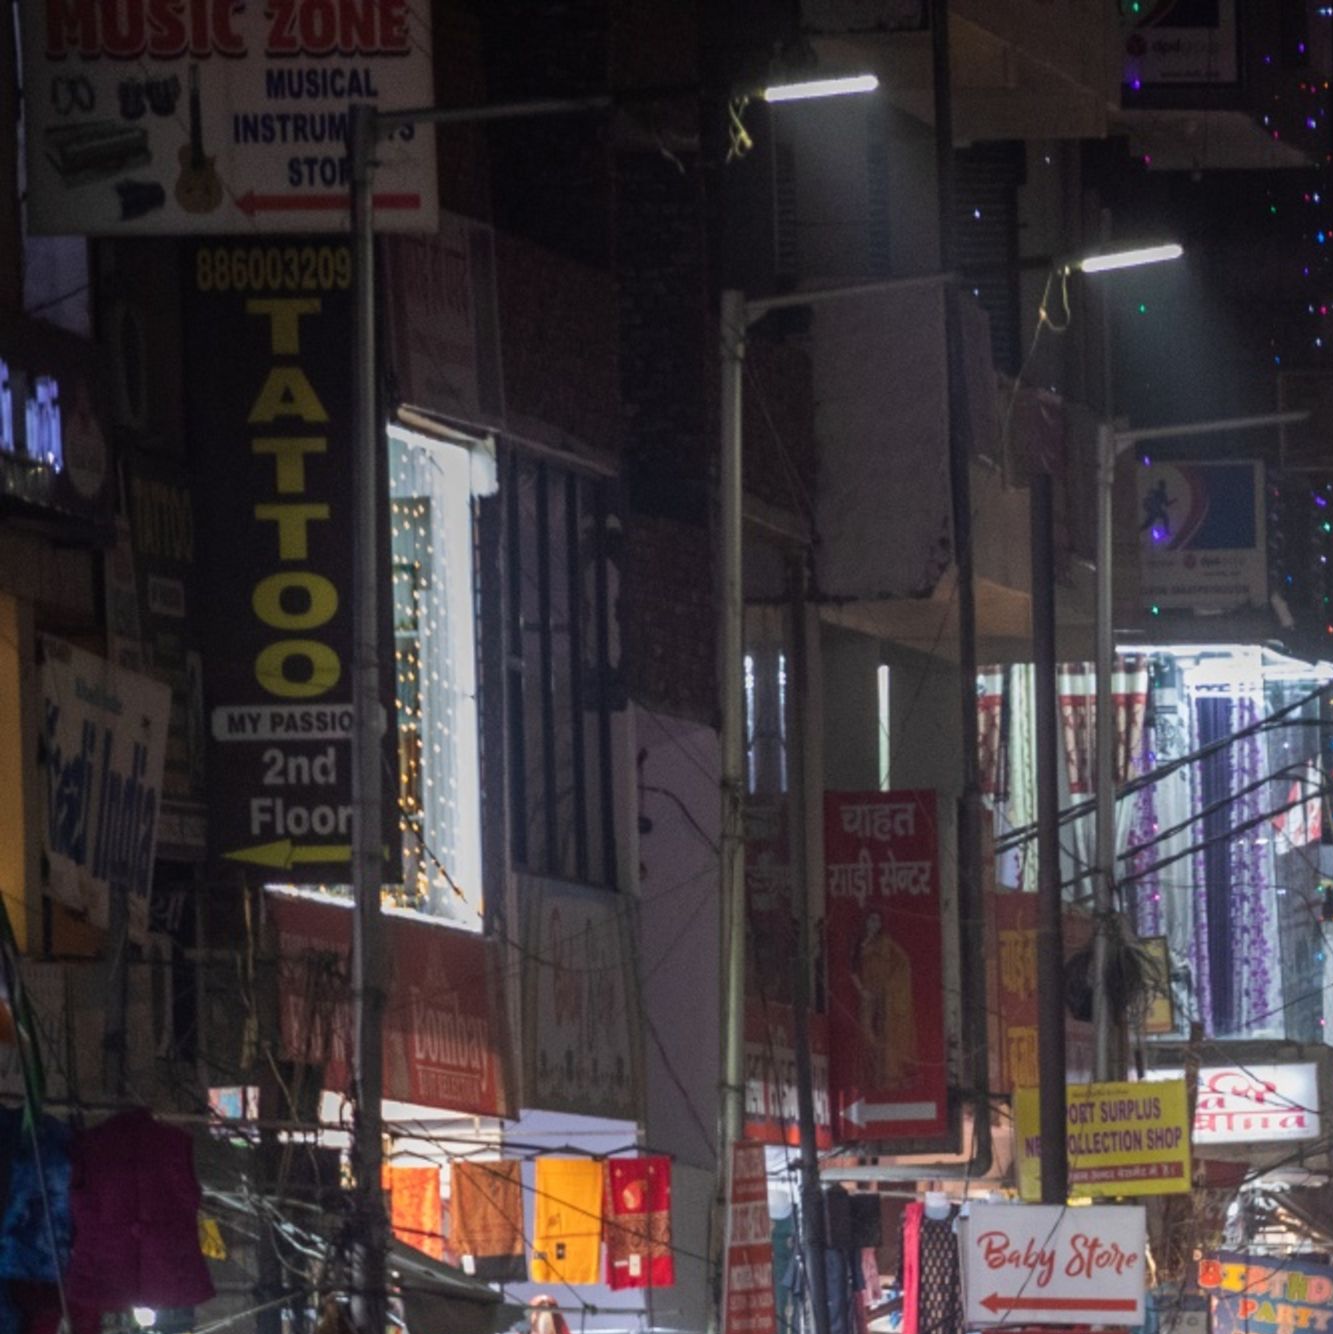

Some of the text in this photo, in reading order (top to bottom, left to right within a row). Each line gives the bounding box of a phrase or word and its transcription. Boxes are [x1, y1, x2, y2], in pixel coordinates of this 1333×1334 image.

[45, 0, 411, 60] MUSIC ZONE
[265, 69, 378, 99] MUSICAL
[233, 113, 415, 144] INSTRUMS
[197, 247, 352, 291] 886003209
[244, 297, 342, 699] TATTOO
[228, 711, 354, 734] MY PASSIO
[262, 747, 337, 785] 2nd
[250, 797, 354, 836] Floor
[839, 802, 917, 842] चाहत
[1067, 1097, 1161, 1125] ORT SURPLUS
[1068, 1129, 1142, 1155] OLLECTION
[1147, 1127, 1182, 1150] SHOP
[977, 1231, 1137, 1287] Baby Store
